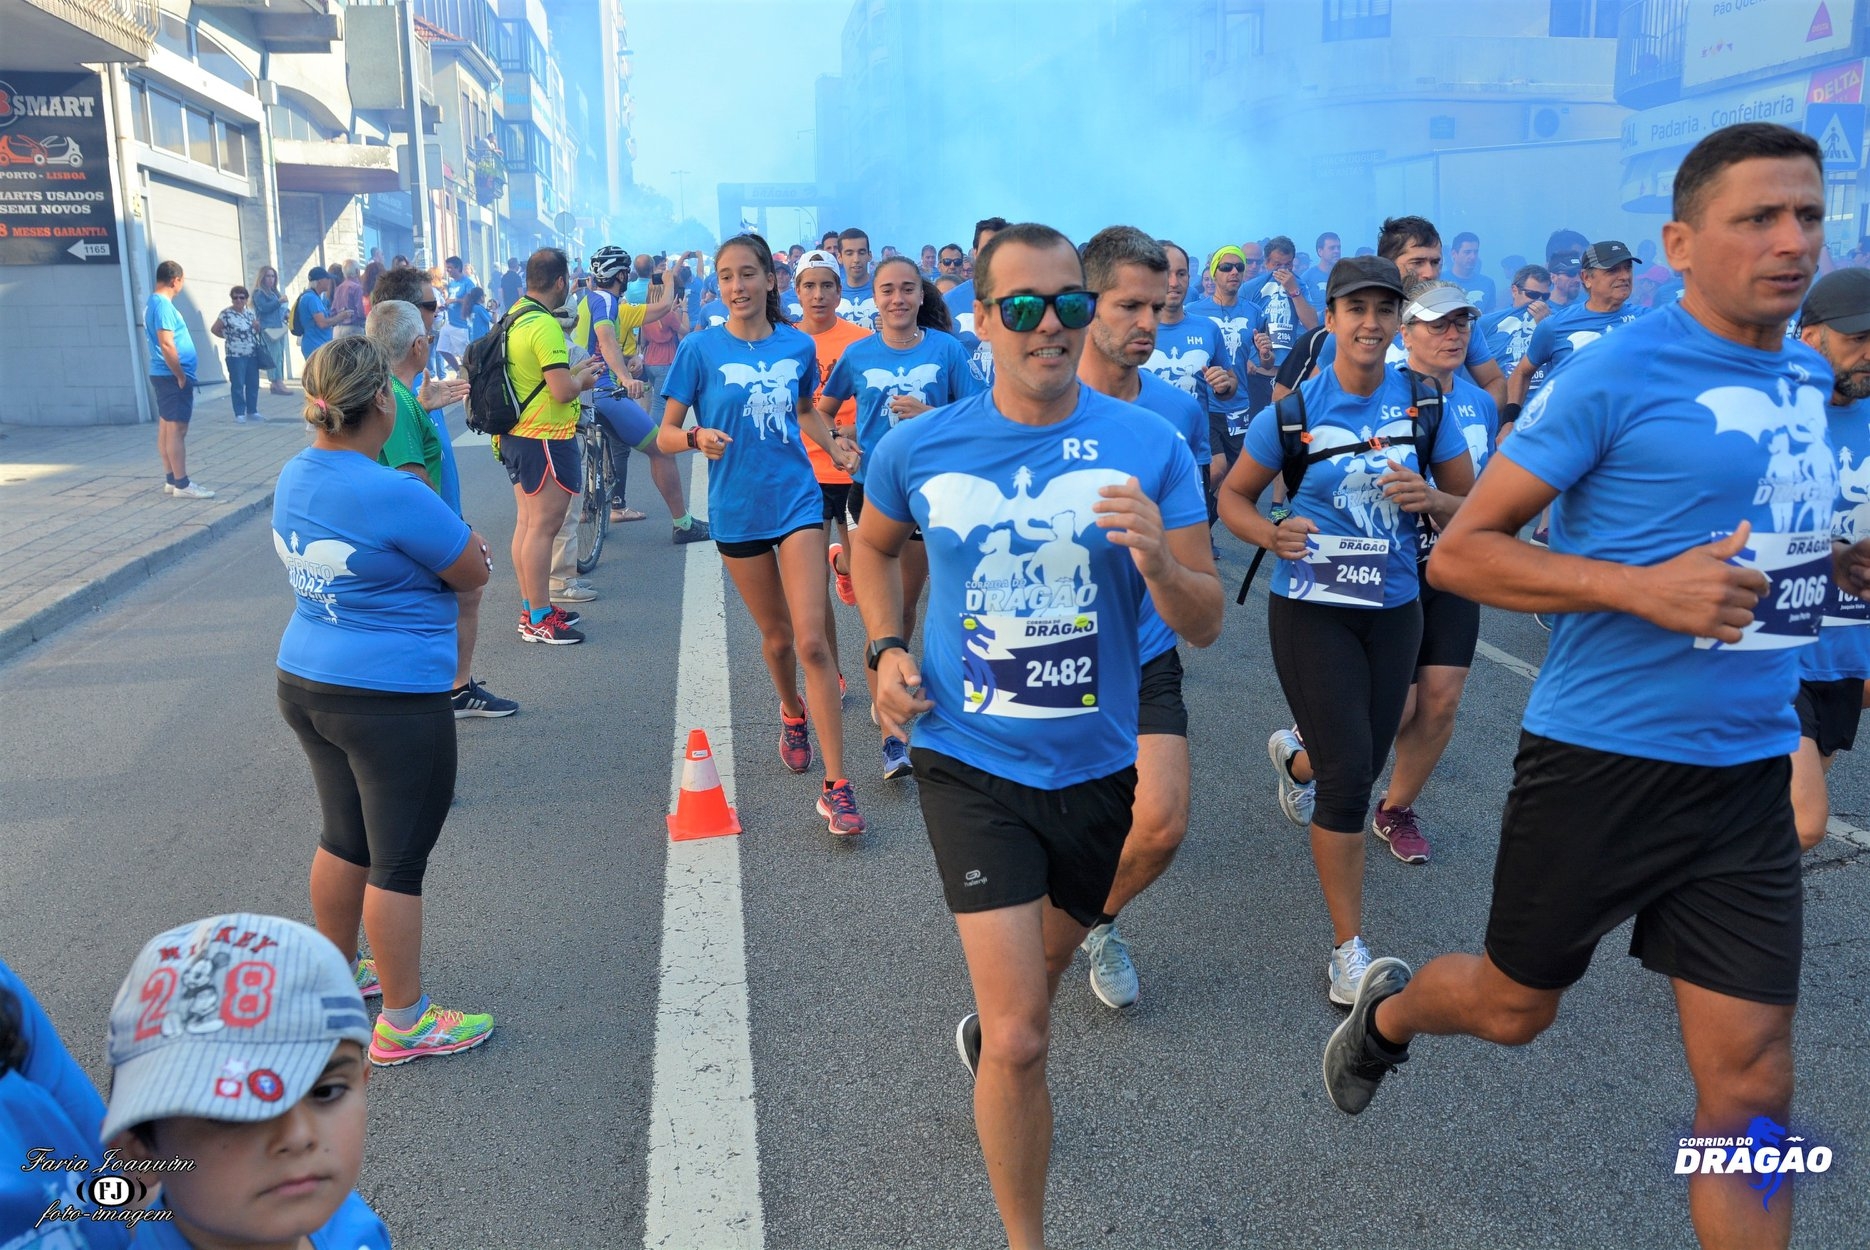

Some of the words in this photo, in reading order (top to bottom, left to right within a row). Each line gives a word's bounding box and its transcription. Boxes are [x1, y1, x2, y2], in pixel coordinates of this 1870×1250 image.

[1812, 69, 1860, 103] DELTA
[1650, 115, 1699, 142] Padaria
[1711, 95, 1794, 129] Confeitaria
[0, 171, 37, 180] PORTO
[46, 172, 86, 180] LISBOA
[45, 191, 105, 201] USADOS
[0, 204, 38, 214] SEMI
[40, 204, 91, 214] NOVOS
[12, 227, 51, 237] MESES
[53, 227, 108, 237] GARANTIA
[85, 245, 106, 253] 1165
[1186, 336, 1203, 345] HM
[1381, 404, 1403, 420] SG
[1457, 404, 1477, 417] MS
[1062, 437, 1099, 461] RS
[1336, 565, 1382, 585] 2464
[1776, 574, 1828, 610] 2066
[1026, 656, 1092, 688] 2482
